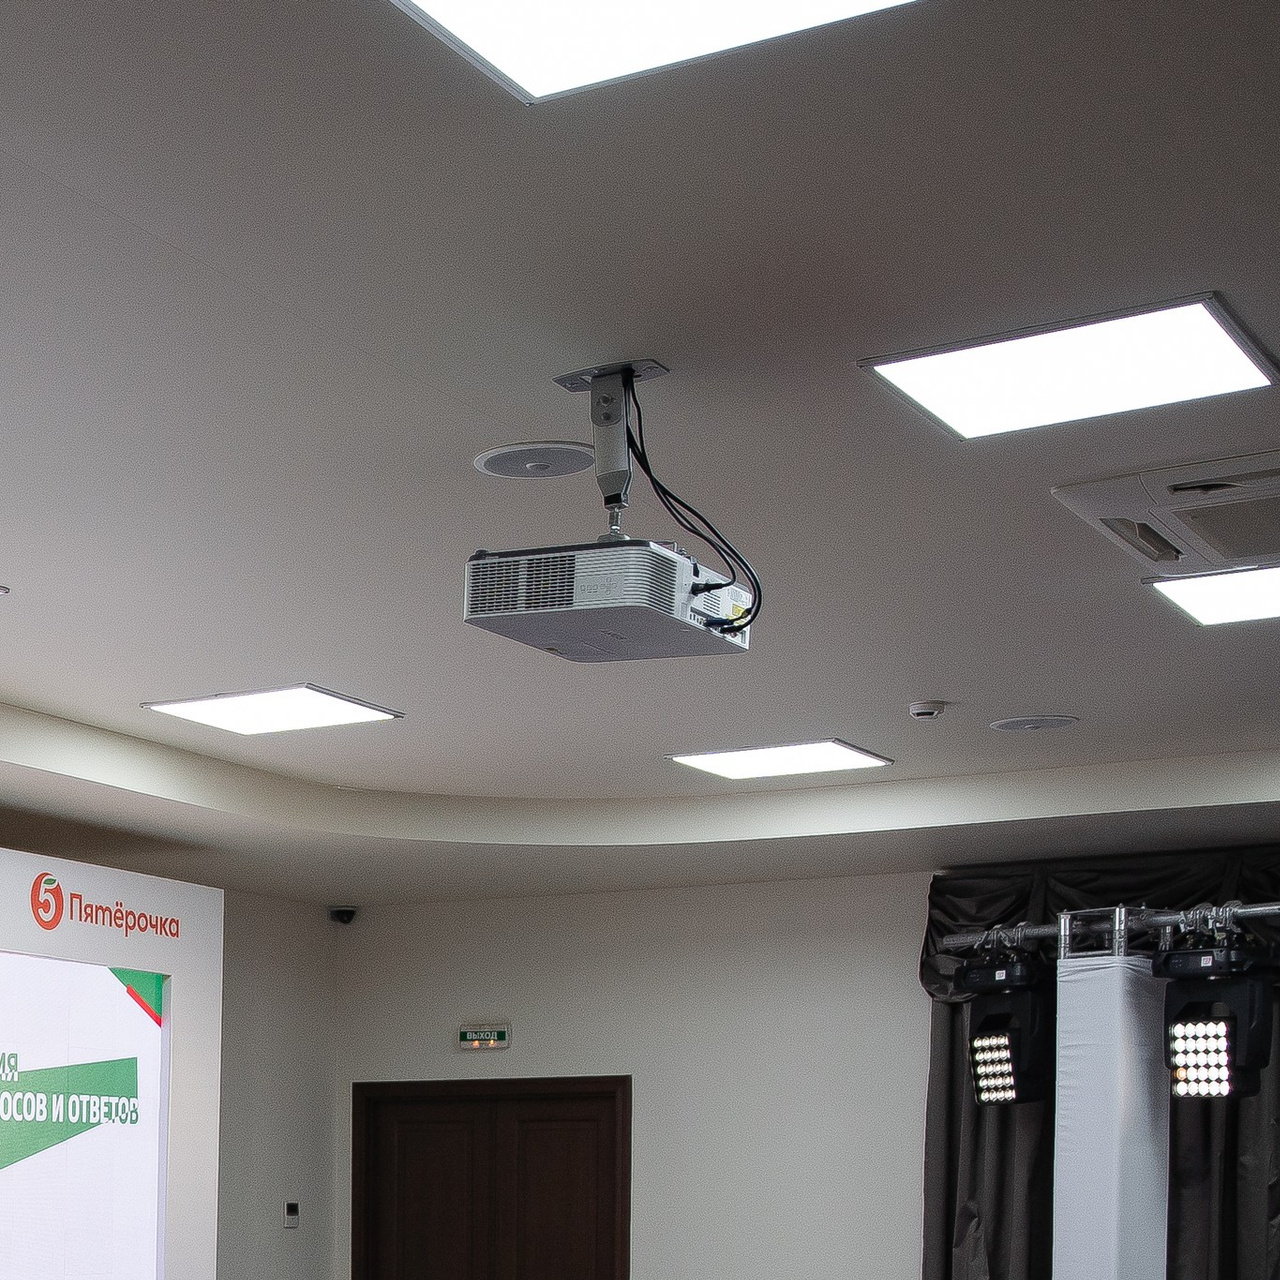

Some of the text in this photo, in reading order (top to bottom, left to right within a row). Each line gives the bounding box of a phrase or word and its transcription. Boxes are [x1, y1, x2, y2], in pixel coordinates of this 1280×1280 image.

[69, 892, 180, 938] Пятёрочка
[466, 1031, 498, 1040] ВЫХОД
[52, 1093, 65, 1124] И
[69, 1094, 139, 1125] ОТВЕТОВ
